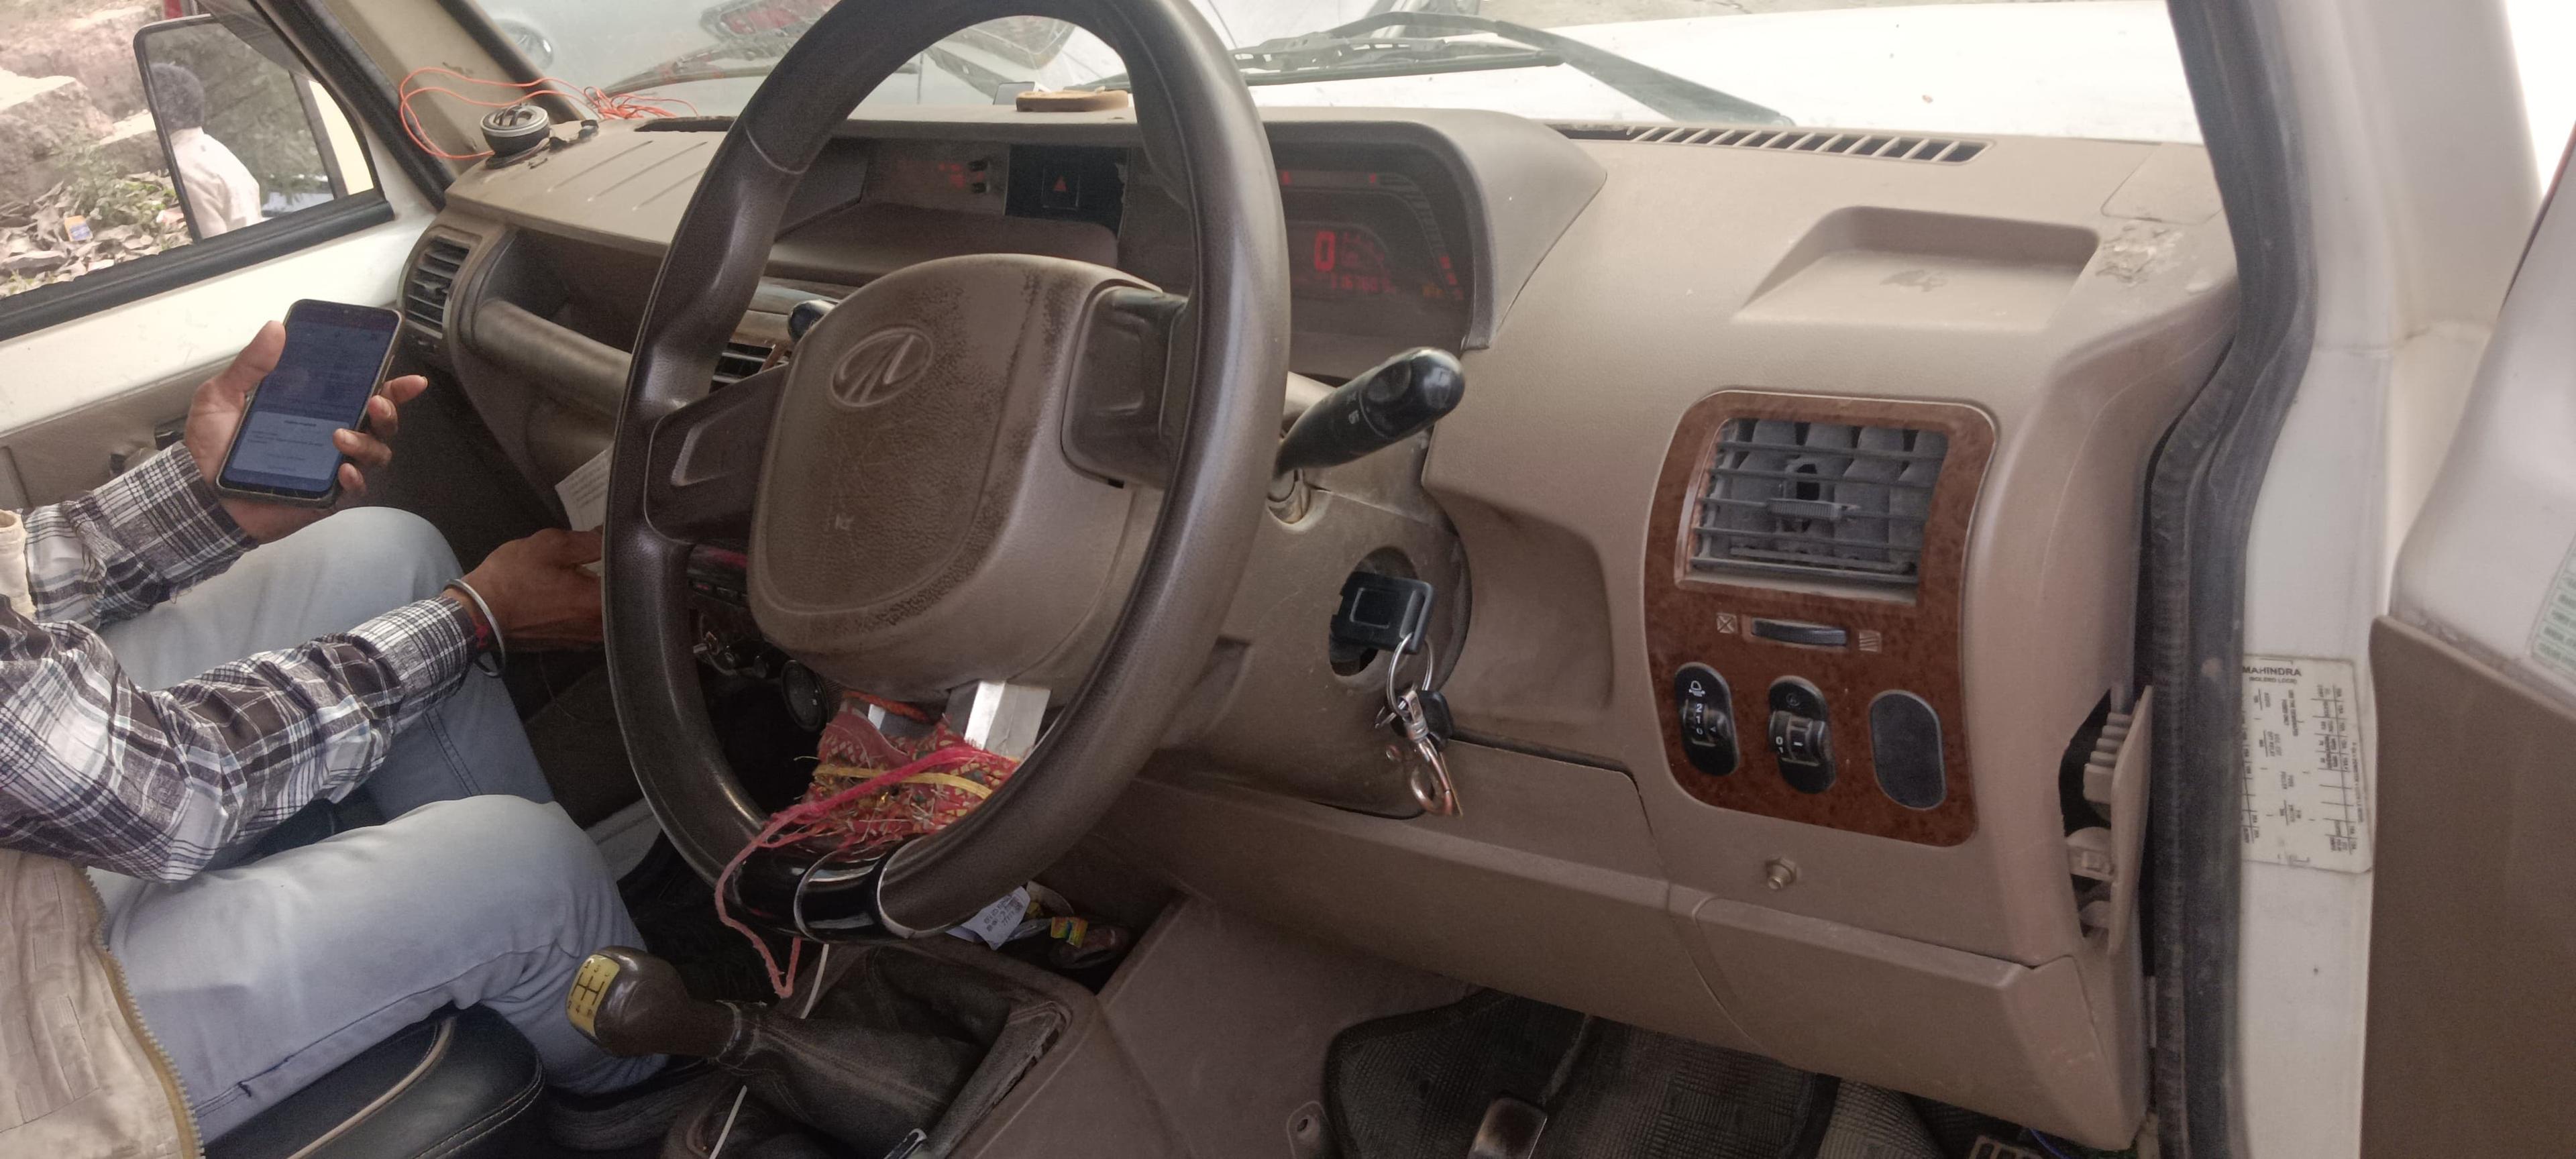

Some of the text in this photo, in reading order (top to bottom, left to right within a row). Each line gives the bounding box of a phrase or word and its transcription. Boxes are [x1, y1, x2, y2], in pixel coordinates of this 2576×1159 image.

[1314, 230, 1336, 272] 0
[2243, 666, 2302, 677] MAHINDRA
[1696, 704, 1703, 712] 2
[1695, 716, 1701, 724] 1
[1775, 736, 1783, 745] 0
